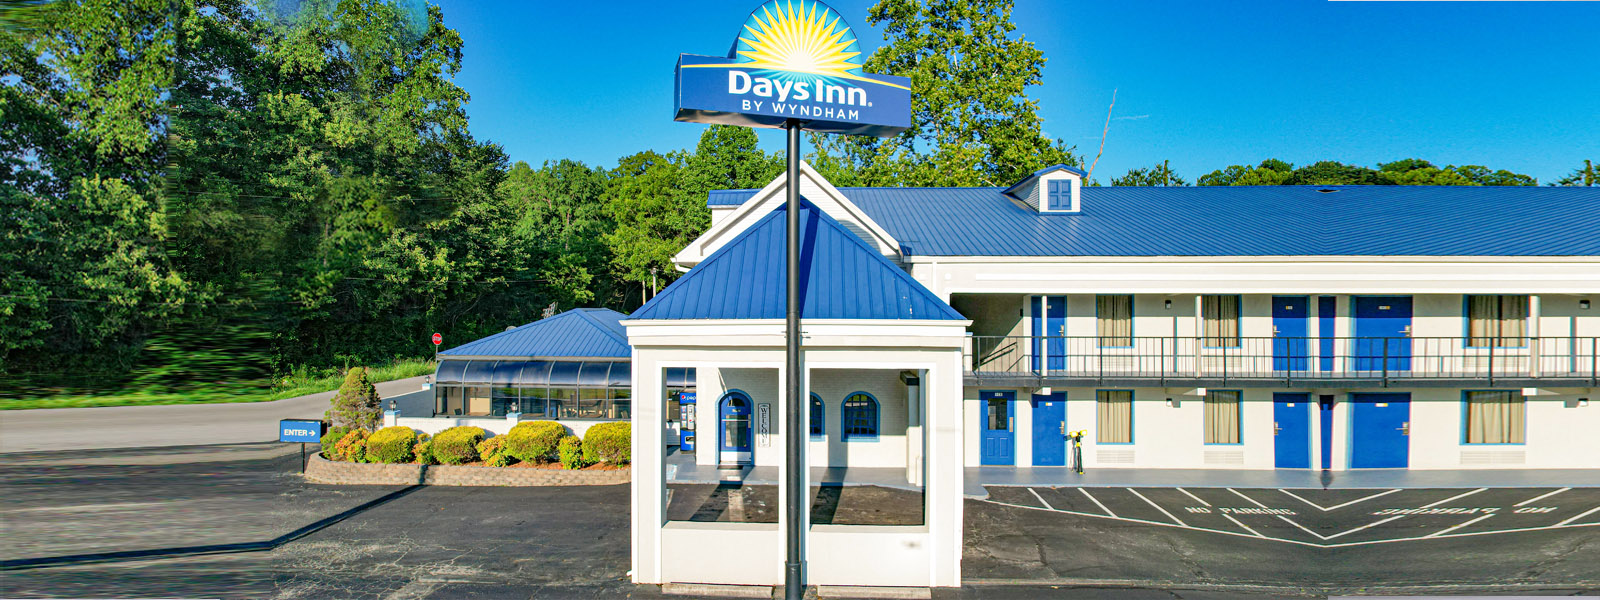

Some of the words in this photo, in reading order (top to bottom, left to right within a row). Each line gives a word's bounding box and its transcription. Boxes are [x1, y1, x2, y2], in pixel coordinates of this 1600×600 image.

[728, 70, 808, 102] Days
[743, 99, 763, 112] BY
[772, 102, 859, 121] WYNDHAM
[284, 429, 308, 437] ENTER
[1184, 506, 1212, 514] NO
[1218, 507, 1297, 515] PARKING
